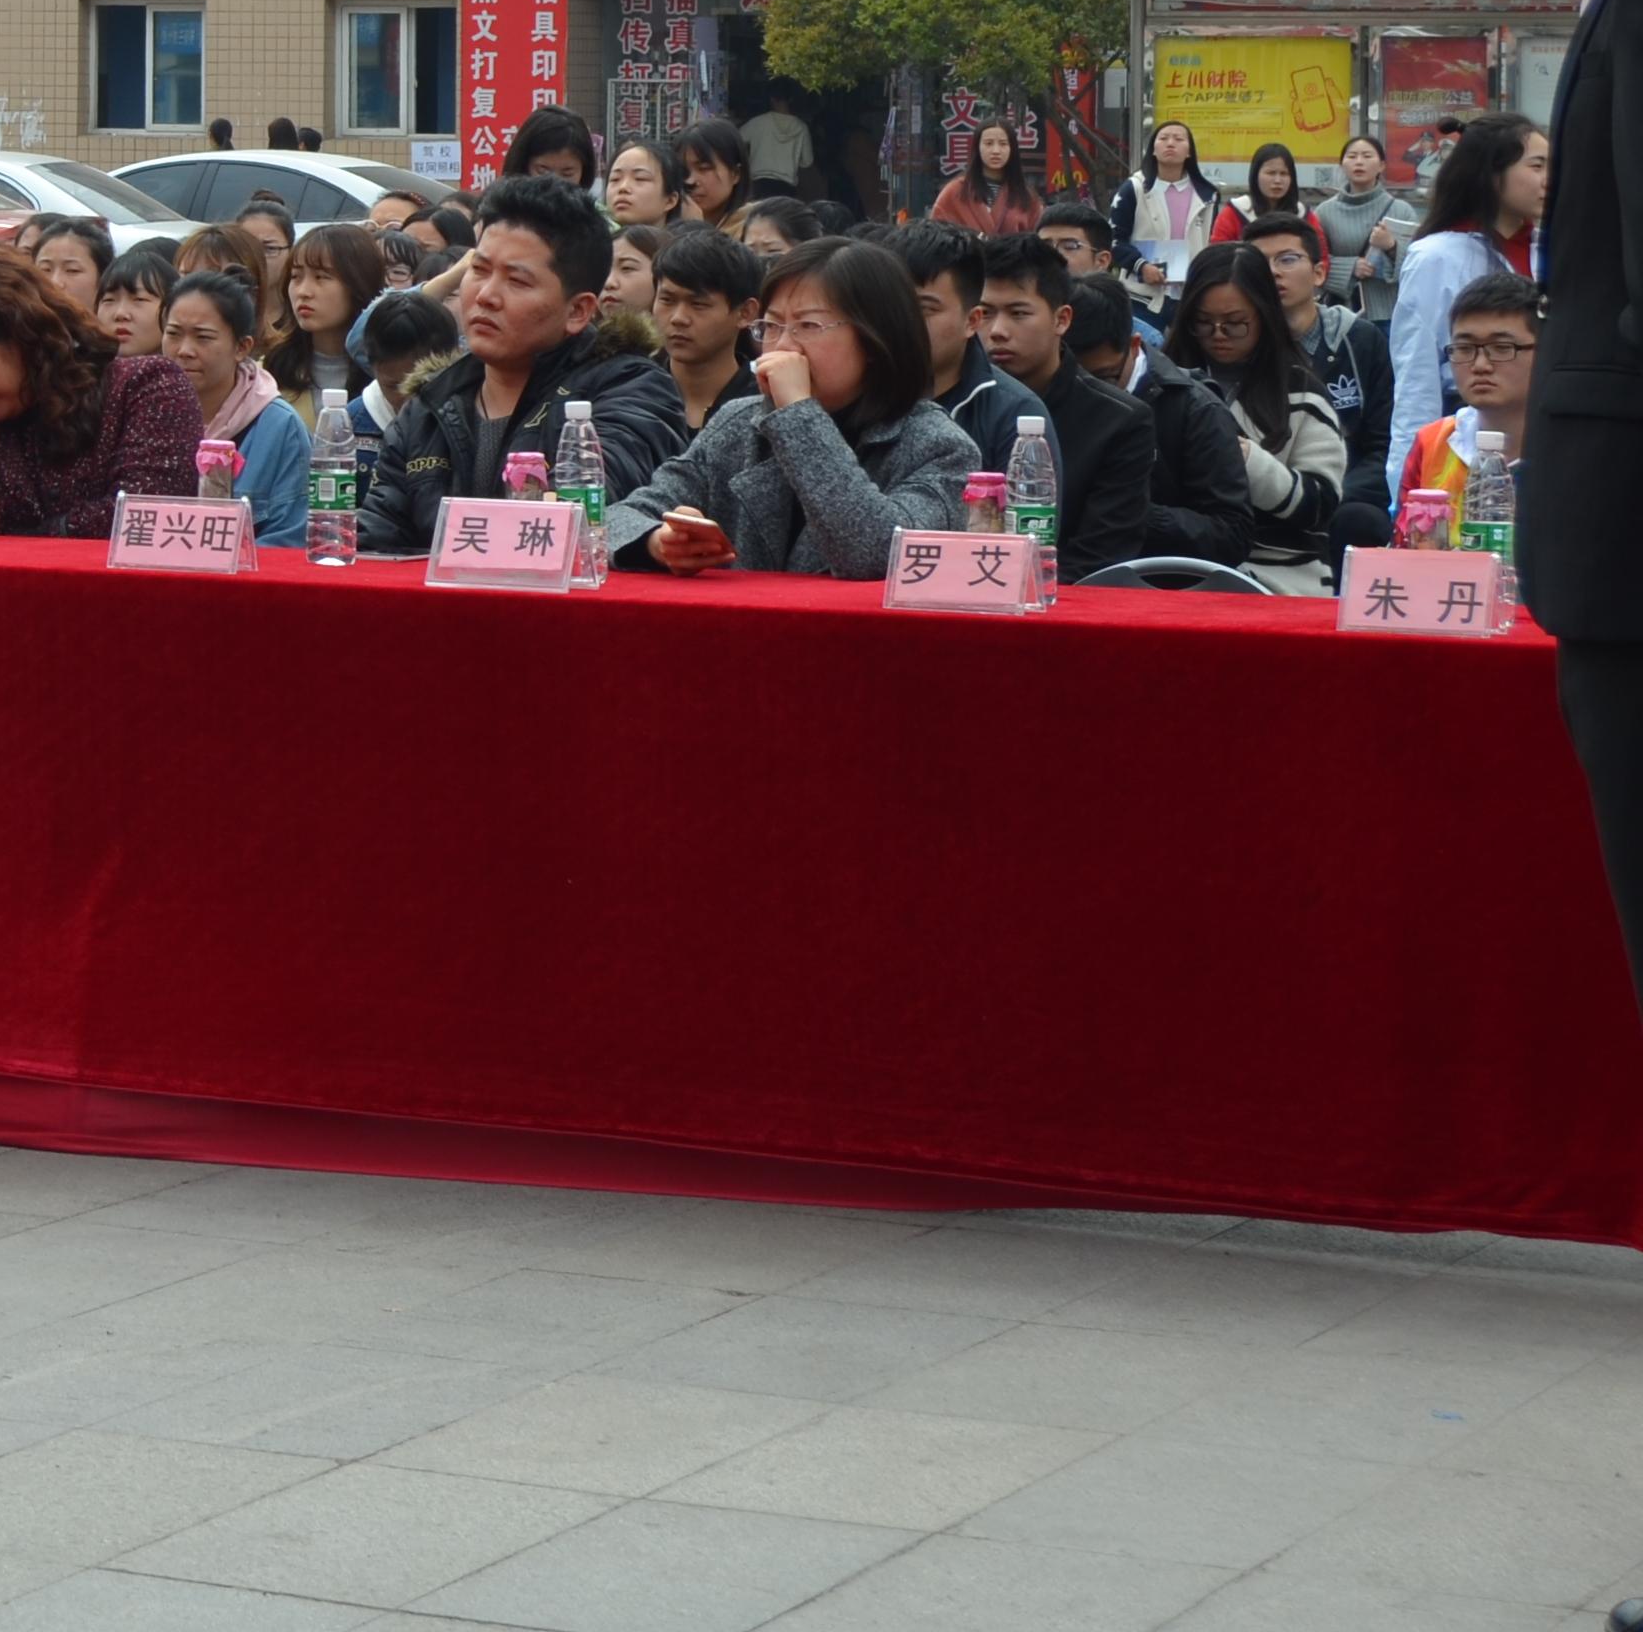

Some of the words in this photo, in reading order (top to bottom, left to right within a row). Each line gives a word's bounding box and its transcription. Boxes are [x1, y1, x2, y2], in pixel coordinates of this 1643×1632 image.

[120, 507, 238, 553] 翟兴旺
[451, 516, 556, 558] 吴琳
[899, 544, 1011, 589] 罗艾
[1364, 577, 1485, 626] 朱丹
